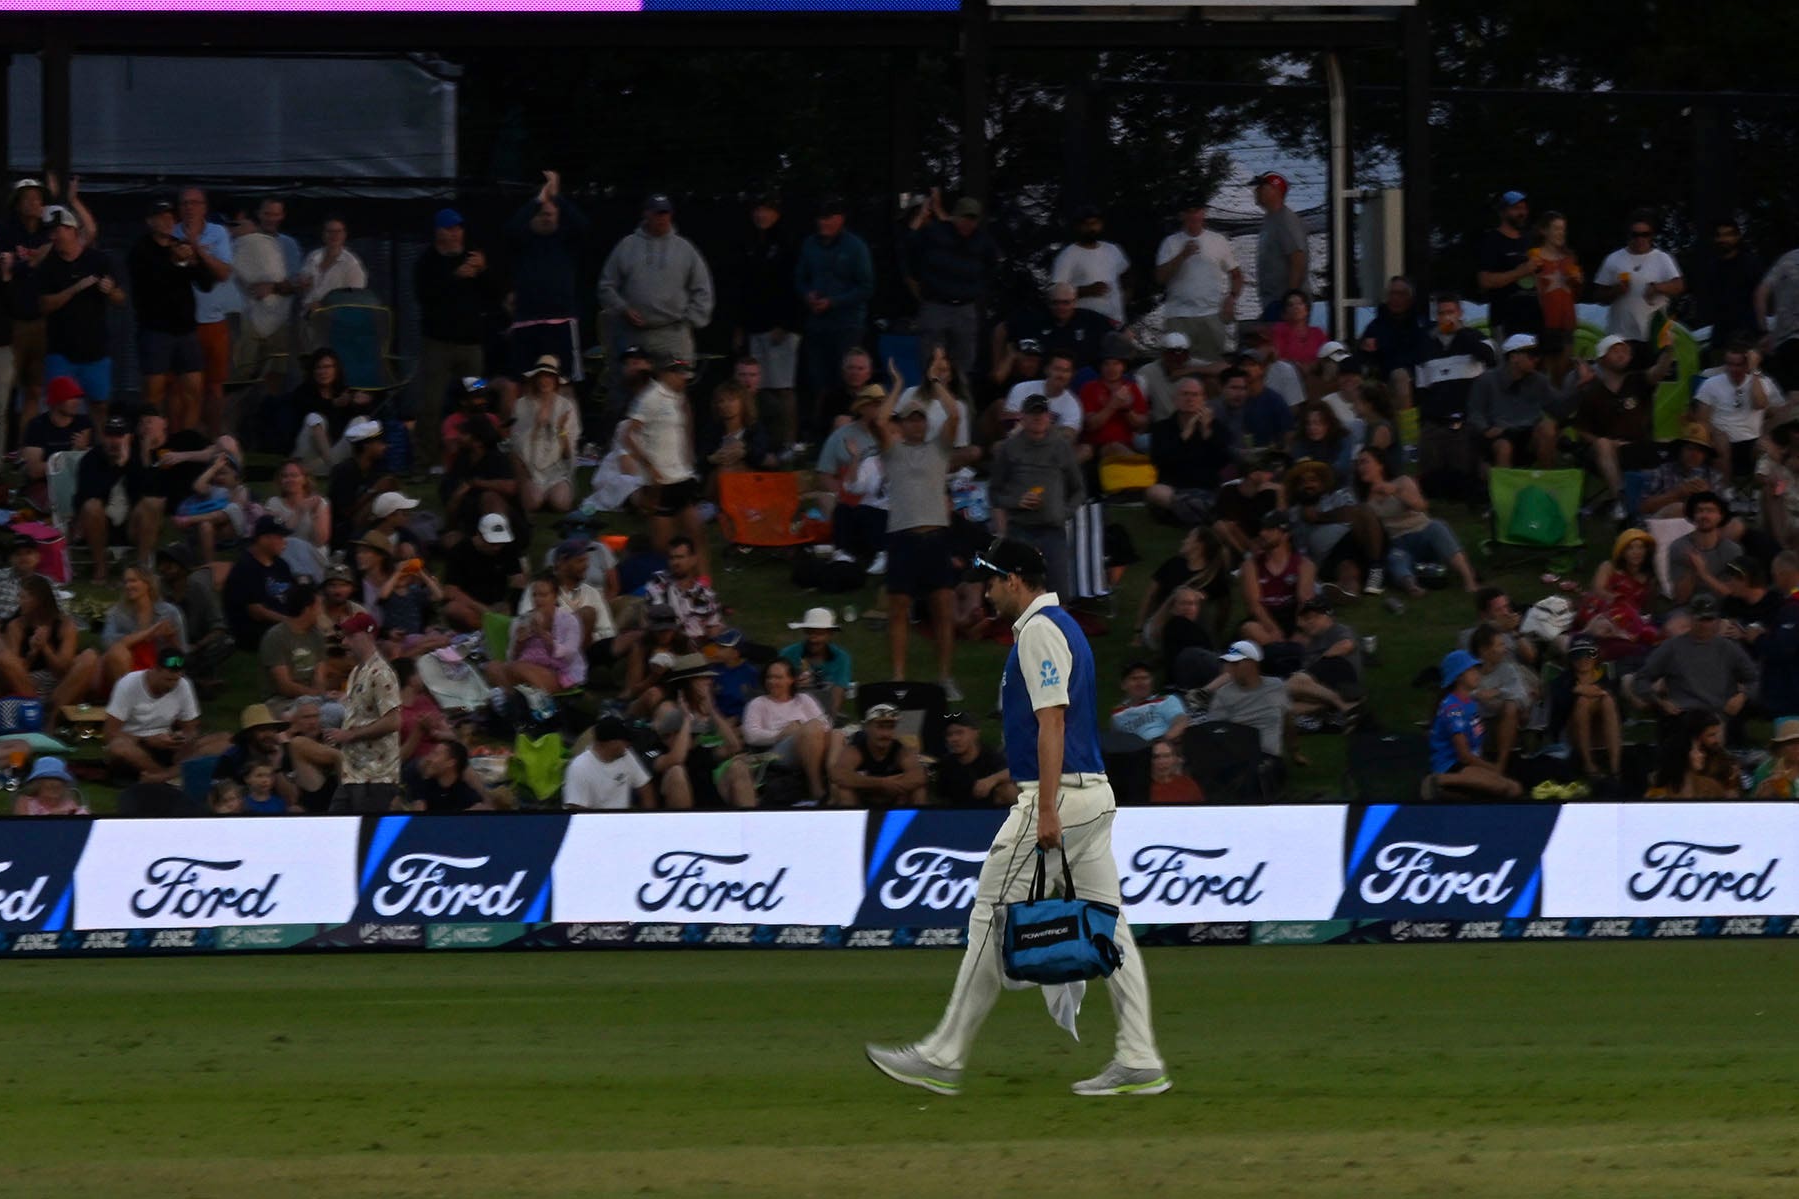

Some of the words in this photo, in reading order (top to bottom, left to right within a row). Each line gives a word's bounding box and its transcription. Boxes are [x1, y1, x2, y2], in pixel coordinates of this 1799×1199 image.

[879, 846, 989, 910] For
[1122, 845, 1268, 905] Ford
[1359, 840, 1517, 906] Ford
[1628, 841, 1780, 902] Ford
[131, 857, 280, 918] Ford
[373, 852, 528, 917] Ford
[637, 851, 788, 912] Ford
[634, 925, 682, 943] ANZ
[704, 925, 751, 943] ANZ
[775, 926, 823, 944] ANZ
[1457, 920, 1501, 938] ANZ
[1523, 919, 1567, 937] ANZ
[1587, 919, 1631, 937] ANZ
[1651, 919, 1698, 937] ANZ
[1719, 919, 1765, 936] ANZ
[13, 933, 59, 951] ANZ
[82, 931, 128, 950] ANZ
[150, 929, 196, 948] ANZ
[846, 929, 893, 947] ANZ
[916, 928, 962, 946] ANZ
